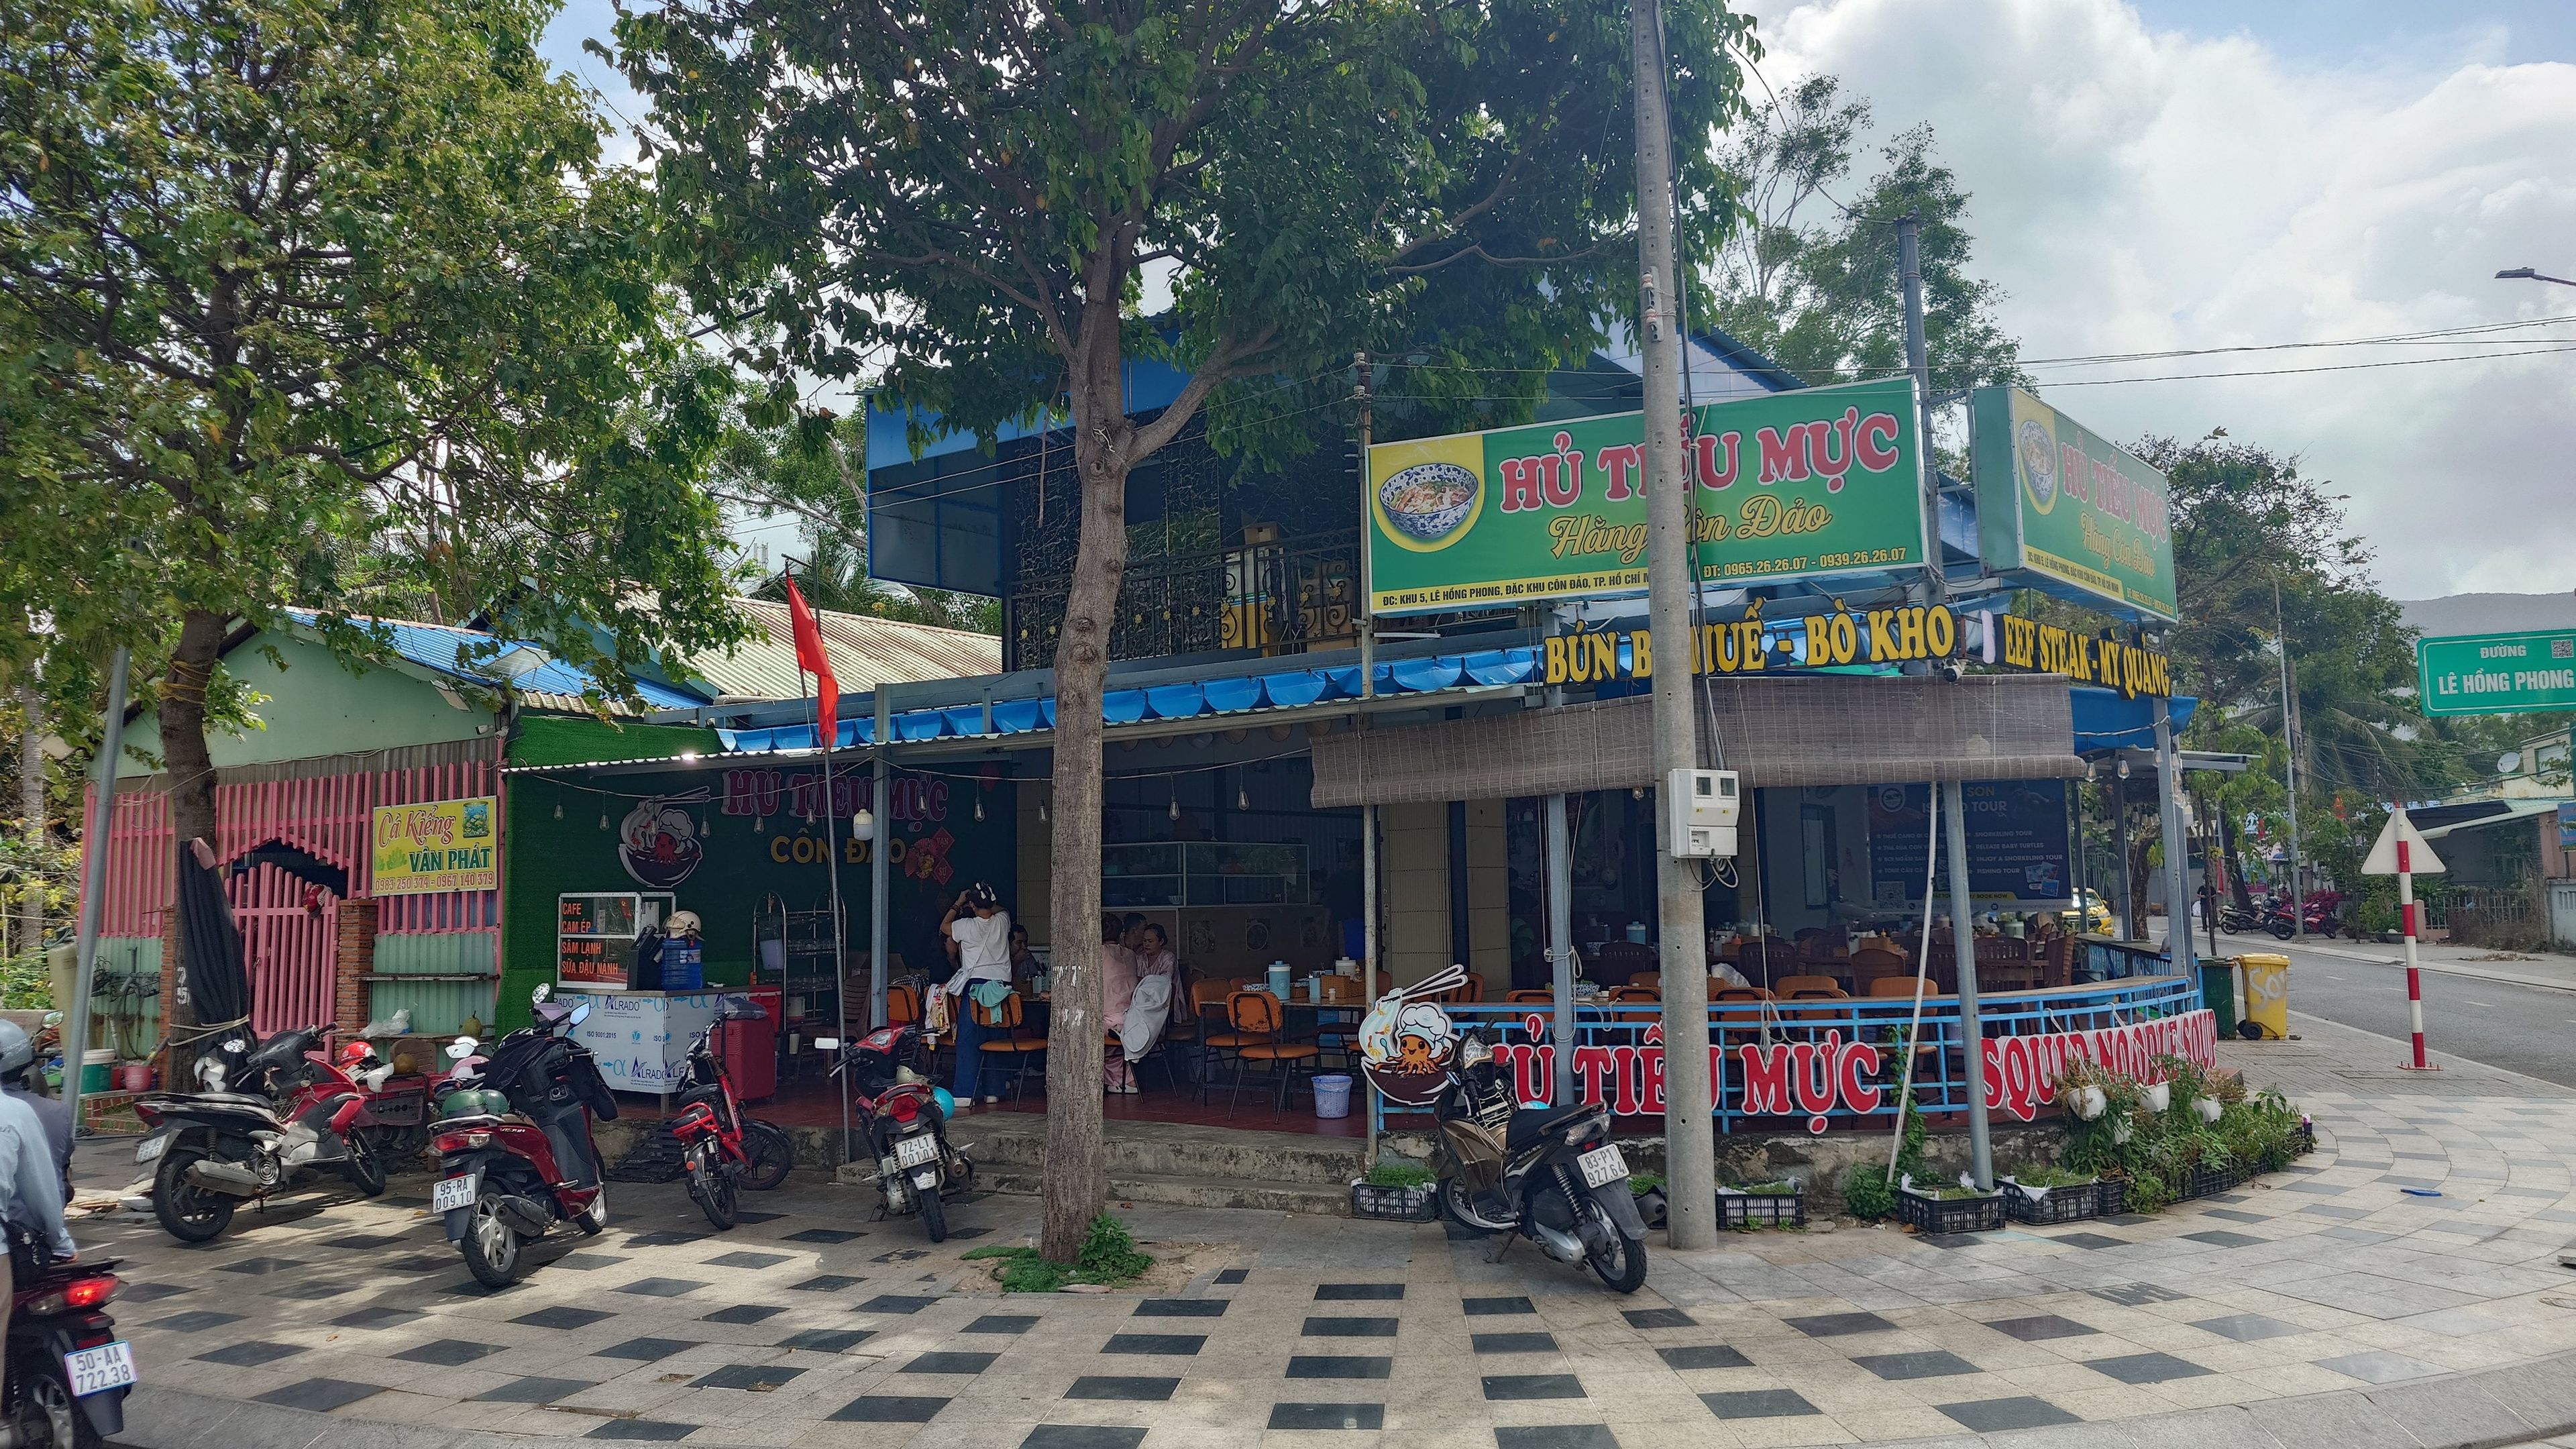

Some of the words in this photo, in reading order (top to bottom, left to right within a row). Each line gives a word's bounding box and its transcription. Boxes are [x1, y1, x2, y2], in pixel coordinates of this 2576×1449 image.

[1499, 430, 1584, 513] HỦ
[1756, 405, 1899, 494] MỰC
[2061, 431, 2088, 502] HỦ
[2091, 449, 2131, 524] TIẾU
[2133, 482, 2167, 550] MỰC
[1548, 514, 1648, 564] Hằng
[1735, 494, 1833, 539] Đảo
[1703, 565, 1720, 578] ĐT:
[1724, 557, 1807, 576] 0965.26.26.07
[1819, 547, 1907, 568] 0939.26.26.07
[1381, 595, 1397, 606] ĐC:
[1399, 594, 1417, 604] KHU
[1419, 592, 1428, 603] 5,
[1430, 590, 1440, 602] LÊ
[1442, 587, 1467, 601] HỒNG
[1469, 587, 1503, 600] PHONG,
[1505, 586, 1524, 596] ĐẶC
[1526, 582, 1545, 594] KHU
[1548, 578, 1567, 592] CÔN
[1569, 576, 1591, 590] ĐẢO,
[1593, 576, 1606, 587] TP.
[1609, 572, 1622, 586] HỒ
[1624, 571, 1641, 584] CHÍ
[1544, 619, 1618, 684] BÚN
[1630, 630, 1652, 678] B
[1777, 639, 1793, 653] -
[1804, 597, 1858, 666] BÒ
[1867, 604, 1955, 662] KHO
[2479, 643, 2527, 658] ĐƯỜNG
[2039, 623, 2092, 681] STEAK
[2123, 633, 2169, 700] QUẢNG
[2438, 672, 2458, 695] LÊ
[2463, 667, 2510, 694] HỒNG
[2514, 669, 2575, 691] PHONG
[1967, 786, 1995, 797] SON
[1972, 801, 2007, 812] TOUR
[378, 812, 401, 849] Cá
[405, 805, 456, 847] Kiểng
[409, 846, 444, 872] VÂN
[447, 843, 492, 870] PHÁT
[845, 838, 906, 864] ĐO
[375, 877, 394, 891] 0983
[396, 876, 412, 890] 250
[414, 875, 430, 888] 374
[437, 873, 457, 888] 0967
[460, 873, 475, 886] 140
[477, 871, 494, 885] 379
[563, 902, 582, 915] CAFE
[561, 920, 578, 933] CAM
[580, 918, 591, 933] ÉP
[561, 939, 578, 953] SÂM
[581, 942, 601, 957] LẠNH
[561, 958, 576, 973] SỮA
[578, 959, 594, 975] ĐẬU
[597, 959, 618, 975] NÀNH
[1739, 1029, 1880, 1134] MỰC
[902, 1136, 929, 1153] 72-L1
[1585, 1148, 1615, 1169] 83-P1
[1587, 1161, 1625, 1186] 927.64
[440, 1178, 468, 1195] 95-RA
[436, 1190, 472, 1210] 009.10
[76, 1346, 122, 1371] 50-AA
[76, 1364, 130, 1393] 722.38
